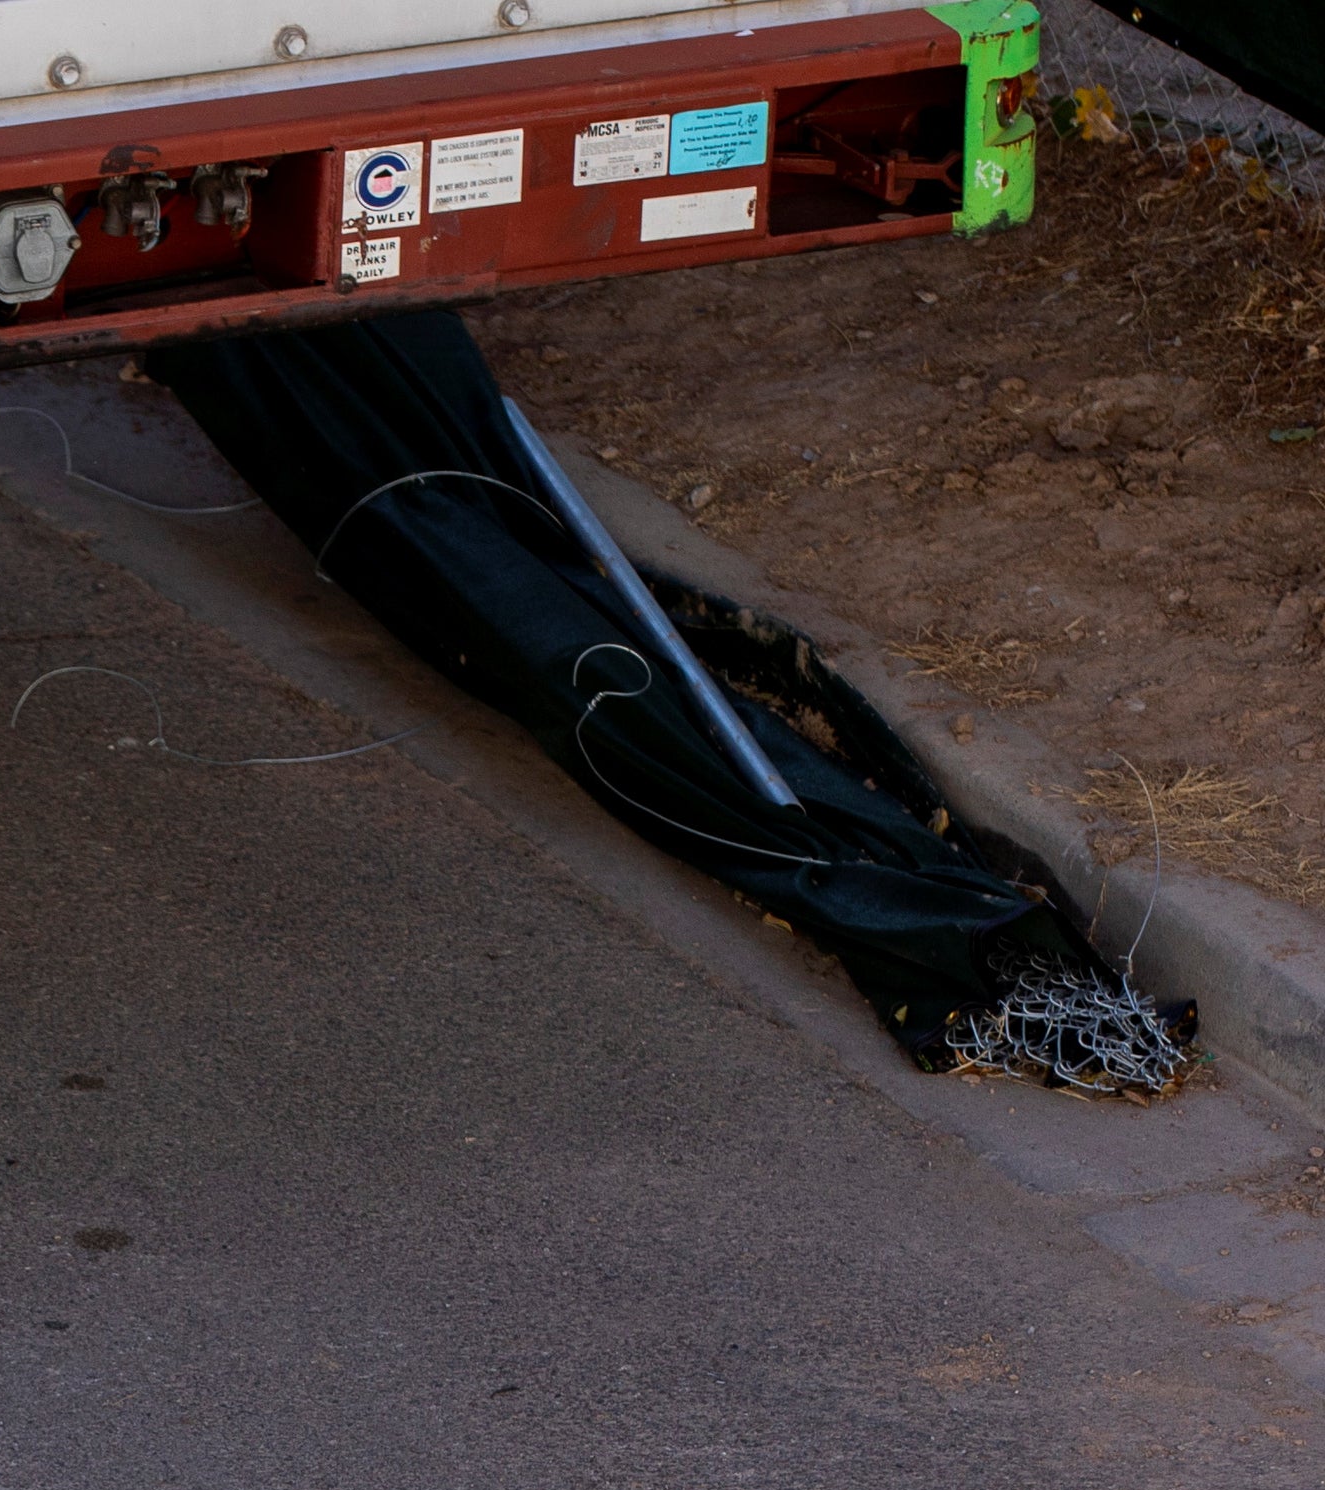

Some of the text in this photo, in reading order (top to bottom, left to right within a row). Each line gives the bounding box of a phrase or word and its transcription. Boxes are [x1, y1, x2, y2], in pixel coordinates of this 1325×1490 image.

[580, 123, 619, 138] MCSA
[635, 124, 665, 132] INSPECTION
[449, 141, 468, 150] CHASSIS
[476, 137, 497, 146] EQUIPPED
[463, 153, 478, 161] BRAKE
[478, 177, 497, 186] CHASSIS
[347, 211, 415, 227] COWLEY
[347, 242, 396, 255] DRIN AIR
[355, 255, 386, 266] TANKS
[356, 268, 384, 279] DAILY
